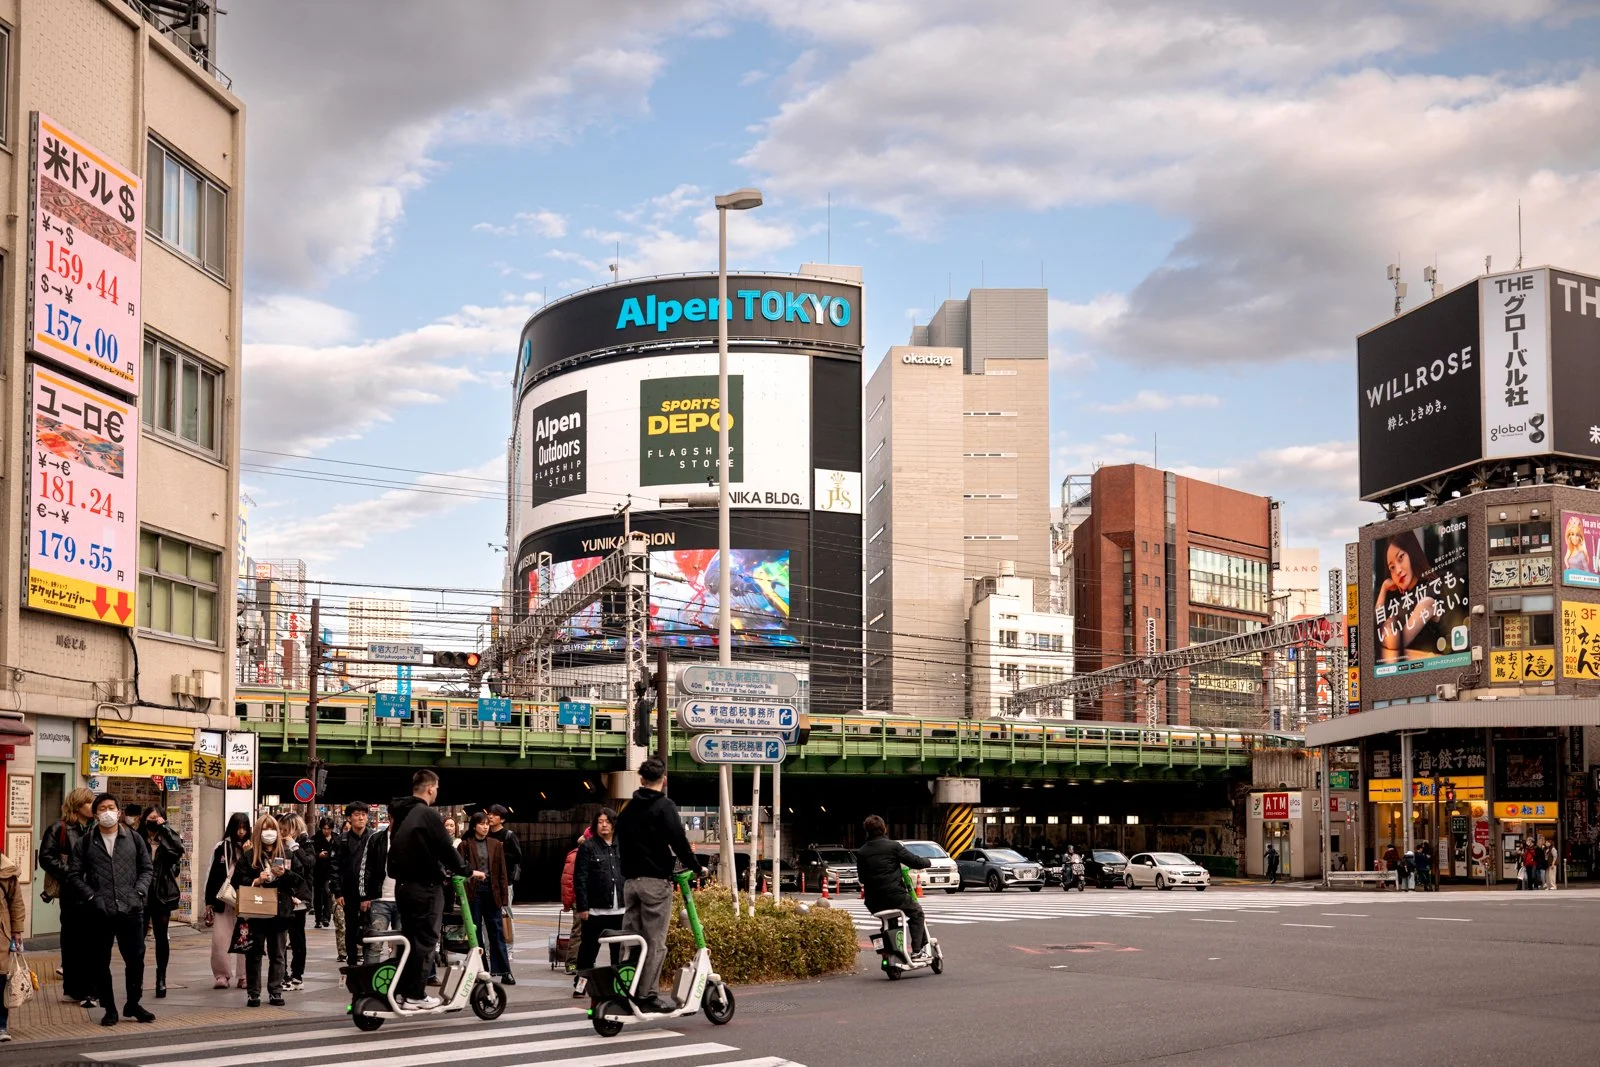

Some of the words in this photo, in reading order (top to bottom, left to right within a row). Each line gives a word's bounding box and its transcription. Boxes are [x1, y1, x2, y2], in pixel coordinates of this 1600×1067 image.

[45, 239, 119, 306] 159.44
[1495, 275, 1534, 294] THE
[616, 294, 733, 332] Alpen
[737, 290, 851, 327] TOKYO
[44, 303, 119, 365] 157.00
[902, 352, 953, 367] okadaya
[1503, 293, 1529, 408] グローバル社
[1366, 346, 1472, 408] WILLROSE
[661, 397, 721, 412] SPORTS
[535, 411, 581, 442] Alpen
[648, 411, 734, 436] DEPO
[1490, 422, 1527, 442] global
[538, 439, 580, 467] Outdoors
[647, 446, 734, 459] FLAGSHP
[534, 459, 581, 481] FLAGSHIP
[548, 471, 581, 487] STORE
[40, 471, 113, 519] 181.24
[729, 491, 762, 504] NIKA
[765, 491, 803, 506] BLDG.
[1440, 521, 1467, 538] paters
[38, 529, 113, 573] 179.55
[581, 536, 625, 553] YUNIKA
[643, 531, 676, 546] SION
[1280, 565, 1318, 573] KANO
[1491, 566, 1519, 586] 江戸
[30, 583, 91, 605] チケットレンジャー
[43, 598, 59, 606] TICKET
[1375, 570, 1466, 625] 自分本位でも、
[1377, 593, 1469, 643] いいじゃない。
[1581, 608, 1597, 621] 3F
[370, 644, 421, 655] 新宿大ガード西
[1508, 652, 1518, 680] おでん
[1565, 656, 1577, 664] 200
[709, 705, 775, 719] 新宿都税事務所
[721, 740, 763, 752] 新宿税務署
[722, 751, 741, 759] Shinjuku
[99, 753, 183, 768] チケットレンジャー
[193, 756, 222, 777] 金券
[1419, 748, 1467, 770] 酒と餃子
[1265, 796, 1287, 810] ATM
[1521, 804, 1545, 815] 松屋
[460, 972, 475, 998] Lime
